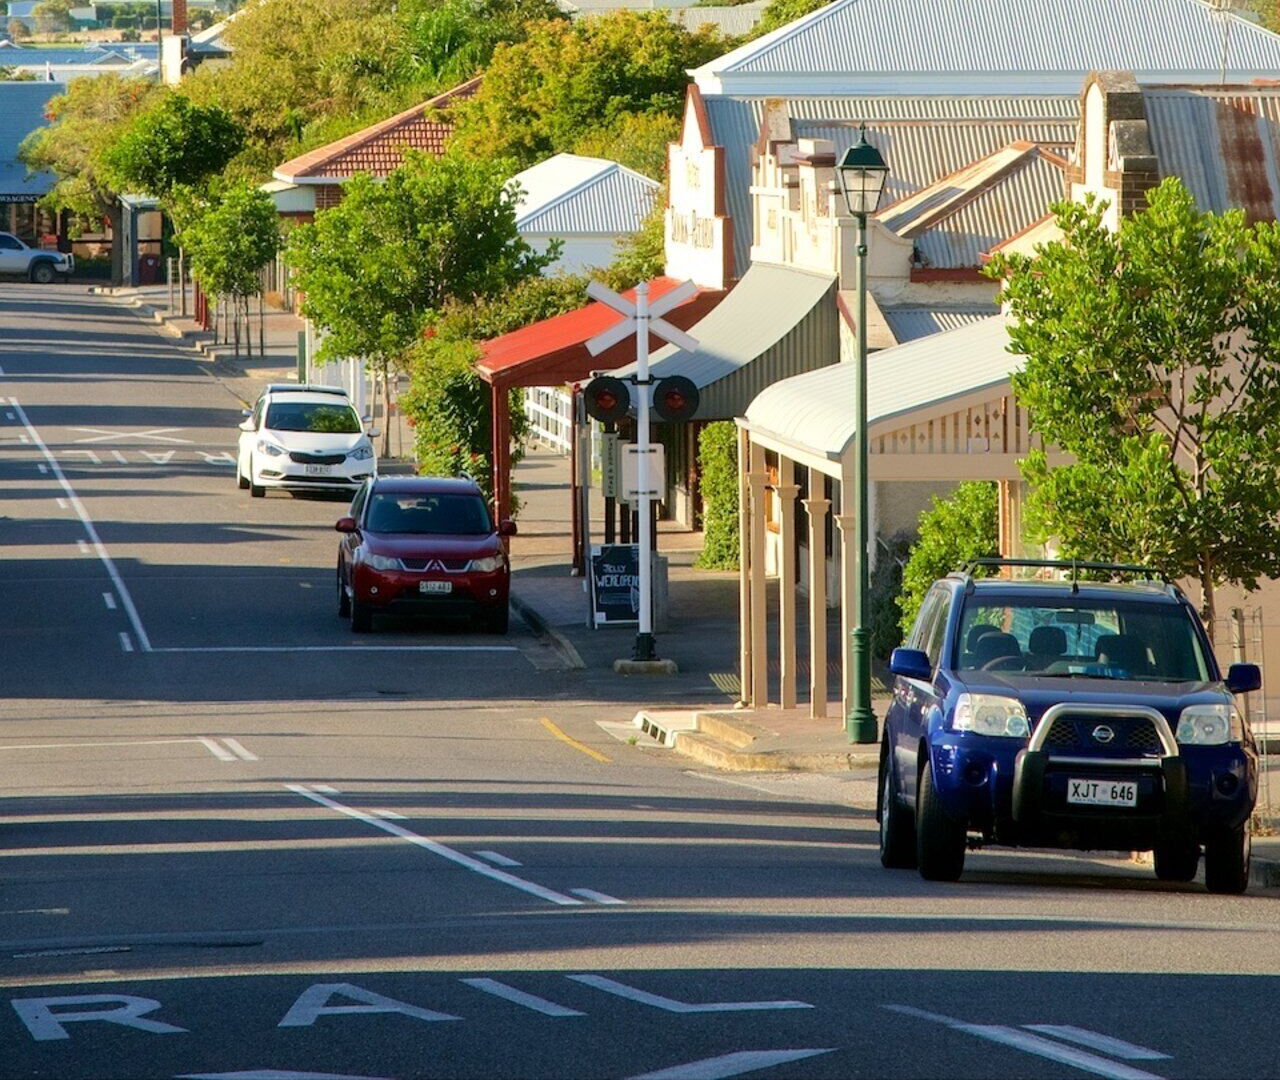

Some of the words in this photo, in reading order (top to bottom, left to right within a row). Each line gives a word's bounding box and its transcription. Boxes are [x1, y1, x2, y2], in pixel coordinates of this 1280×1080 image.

[1072, 783, 1099, 798] XJT
[1111, 786, 1133, 801] 646
[10, 973, 817, 1041] RAIL
